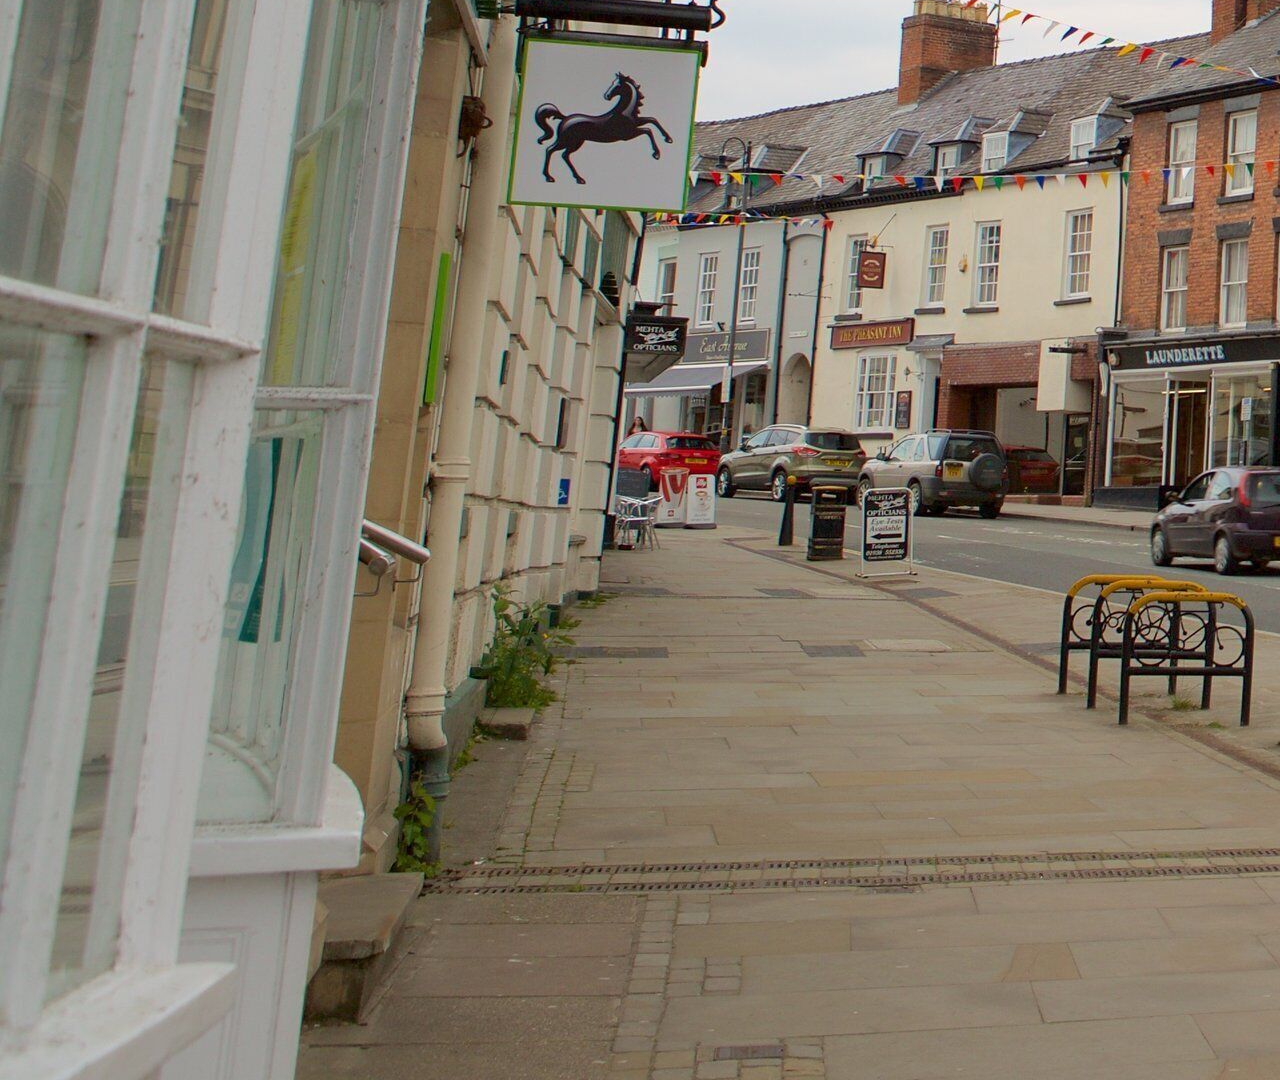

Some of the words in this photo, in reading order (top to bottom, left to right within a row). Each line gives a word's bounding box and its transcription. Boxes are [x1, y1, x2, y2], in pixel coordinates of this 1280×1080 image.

[635, 325, 665, 334] MEHTA
[840, 329, 853, 342] THE
[853, 325, 888, 341] PHEASANT
[889, 324, 903, 339] INN
[633, 343, 678, 352] OPTICIANS
[699, 337, 718, 354] East
[1145, 344, 1225, 364] LAUNDERETTE
[866, 509, 907, 517] OPTICIANS
